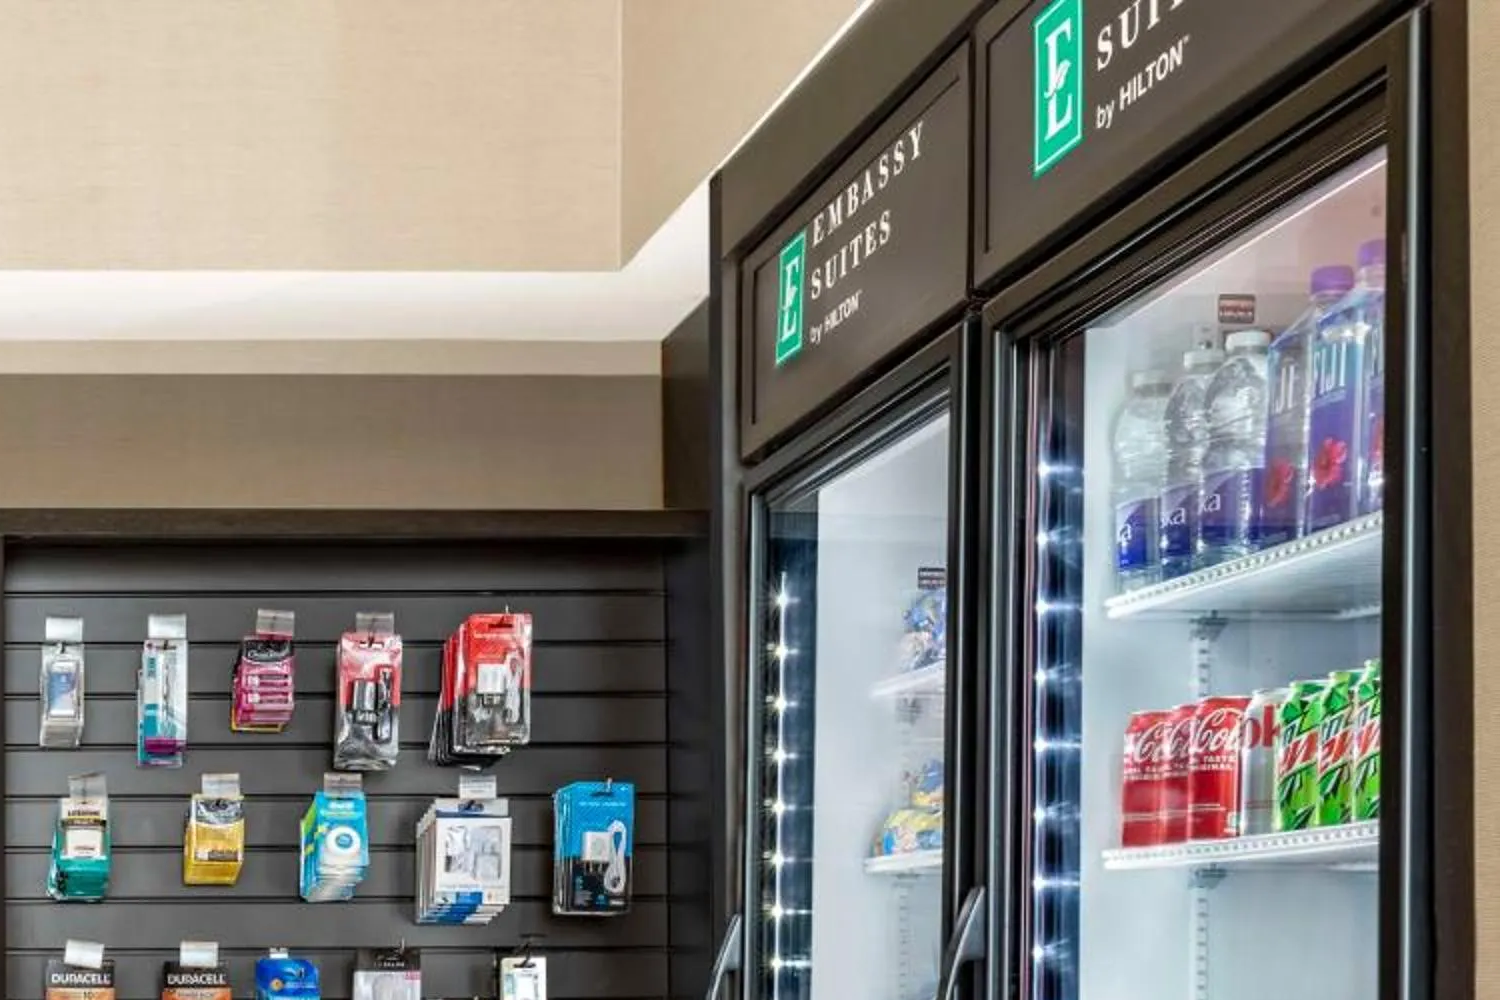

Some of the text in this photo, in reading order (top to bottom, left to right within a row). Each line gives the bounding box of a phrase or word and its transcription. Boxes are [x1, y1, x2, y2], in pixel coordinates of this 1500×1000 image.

[1096, 0, 1184, 71] SUI
[1095, 38, 1184, 130] by HILTON
[812, 120, 924, 248] EMBASSY
[810, 209, 892, 300] SUITES
[809, 291, 861, 345] by HILTON
[51, 972, 111, 985] DURACELL
[167, 972, 227, 985] DURACELL
